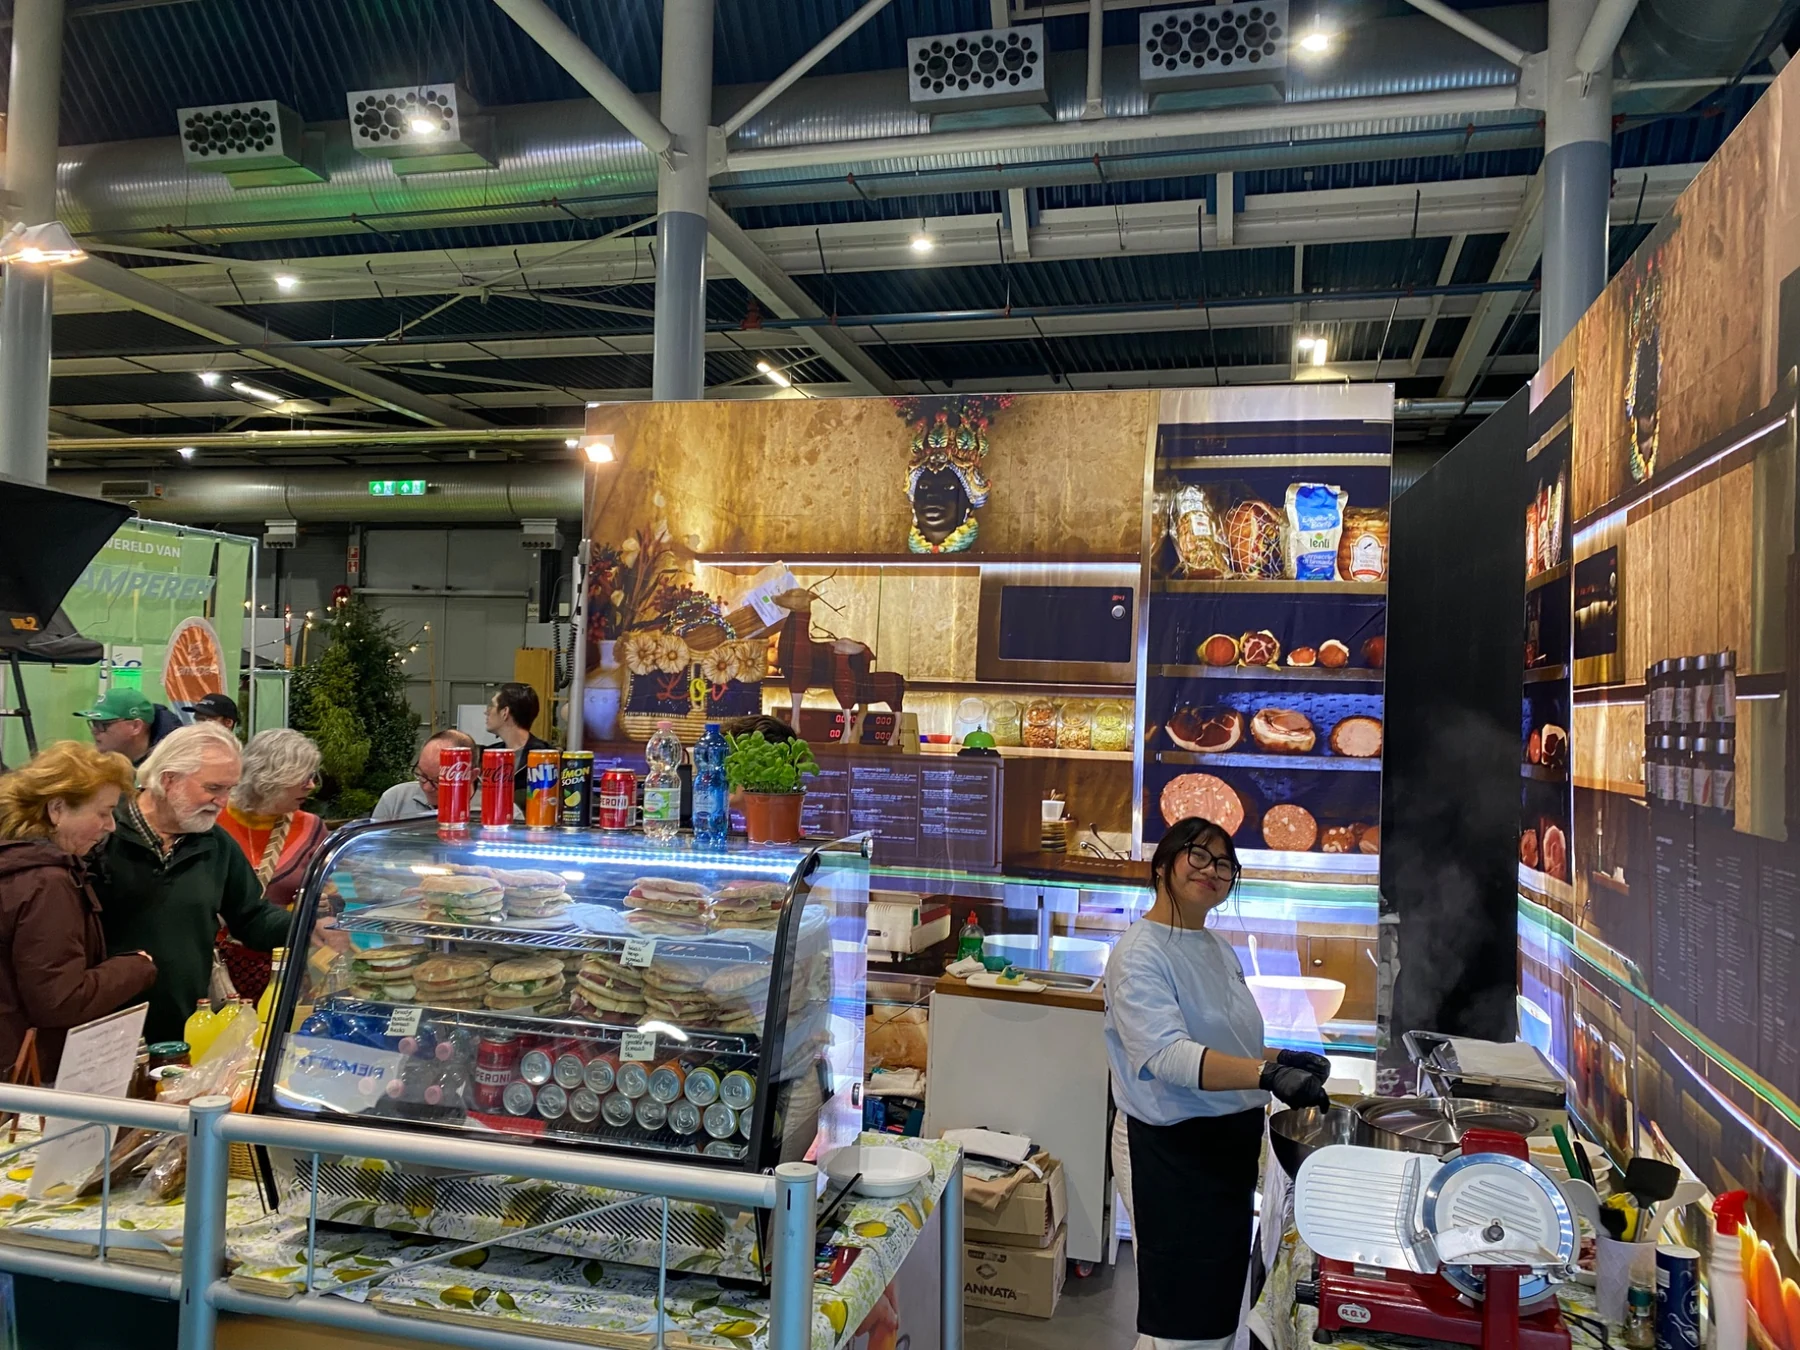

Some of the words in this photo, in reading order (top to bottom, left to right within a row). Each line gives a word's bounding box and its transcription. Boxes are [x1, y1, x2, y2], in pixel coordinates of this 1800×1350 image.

[103, 537, 154, 554] WERELD
[156, 545, 181, 558] VAN
[561, 776, 585, 787] SODA
